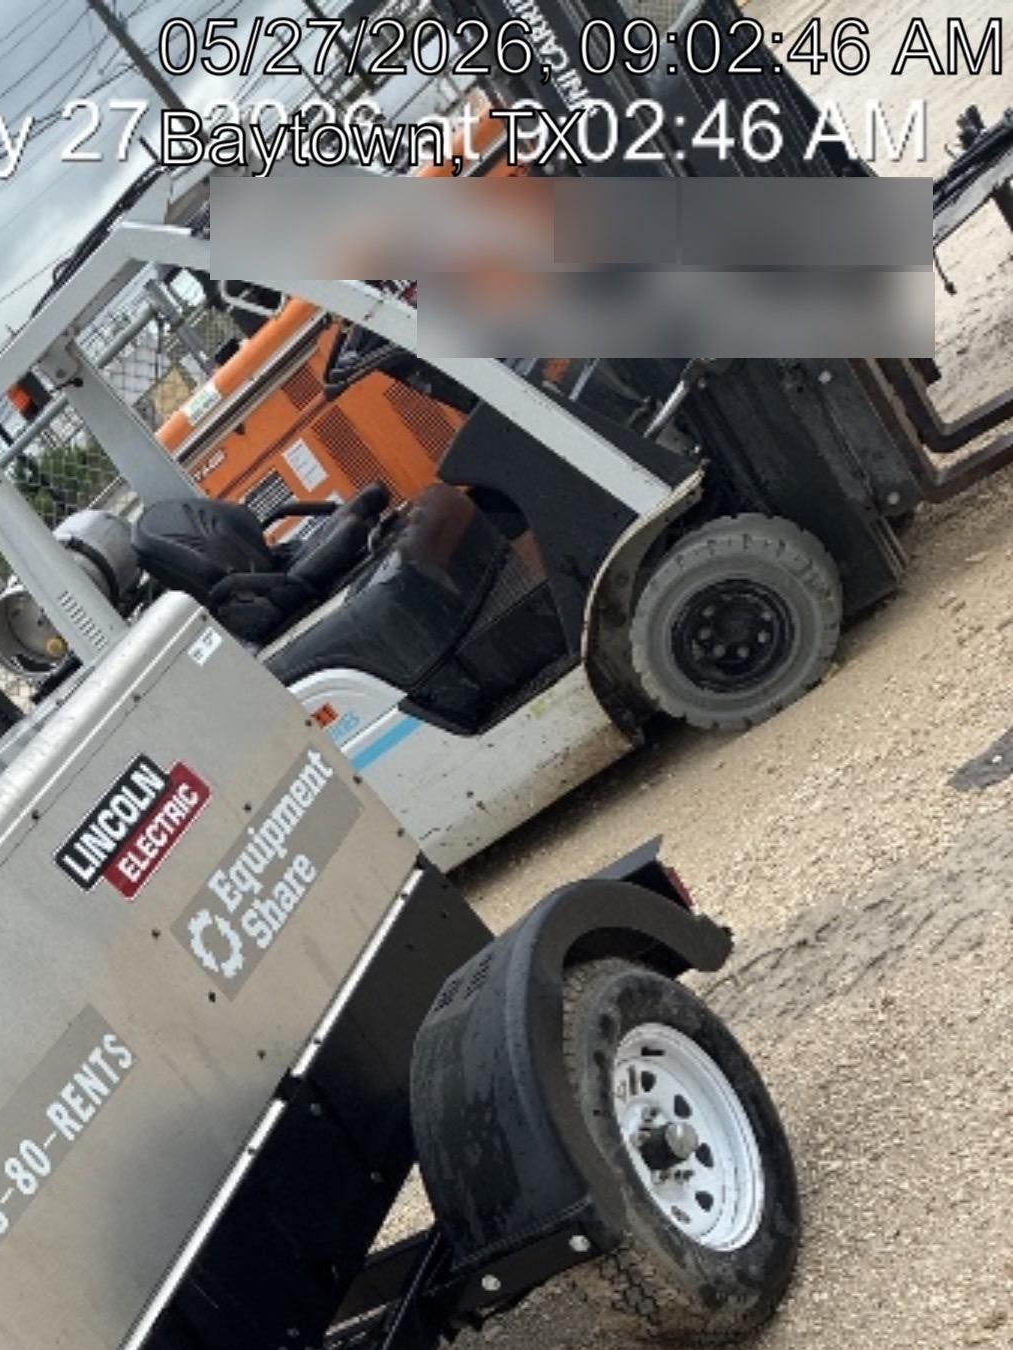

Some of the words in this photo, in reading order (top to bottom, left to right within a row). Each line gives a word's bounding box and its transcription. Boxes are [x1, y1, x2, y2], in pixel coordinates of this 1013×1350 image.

[60, 763, 168, 881] LINCOLN
[117, 782, 202, 883] ELECTRIC
[207, 747, 336, 915] Equipment
[240, 852, 317, 950] Share
